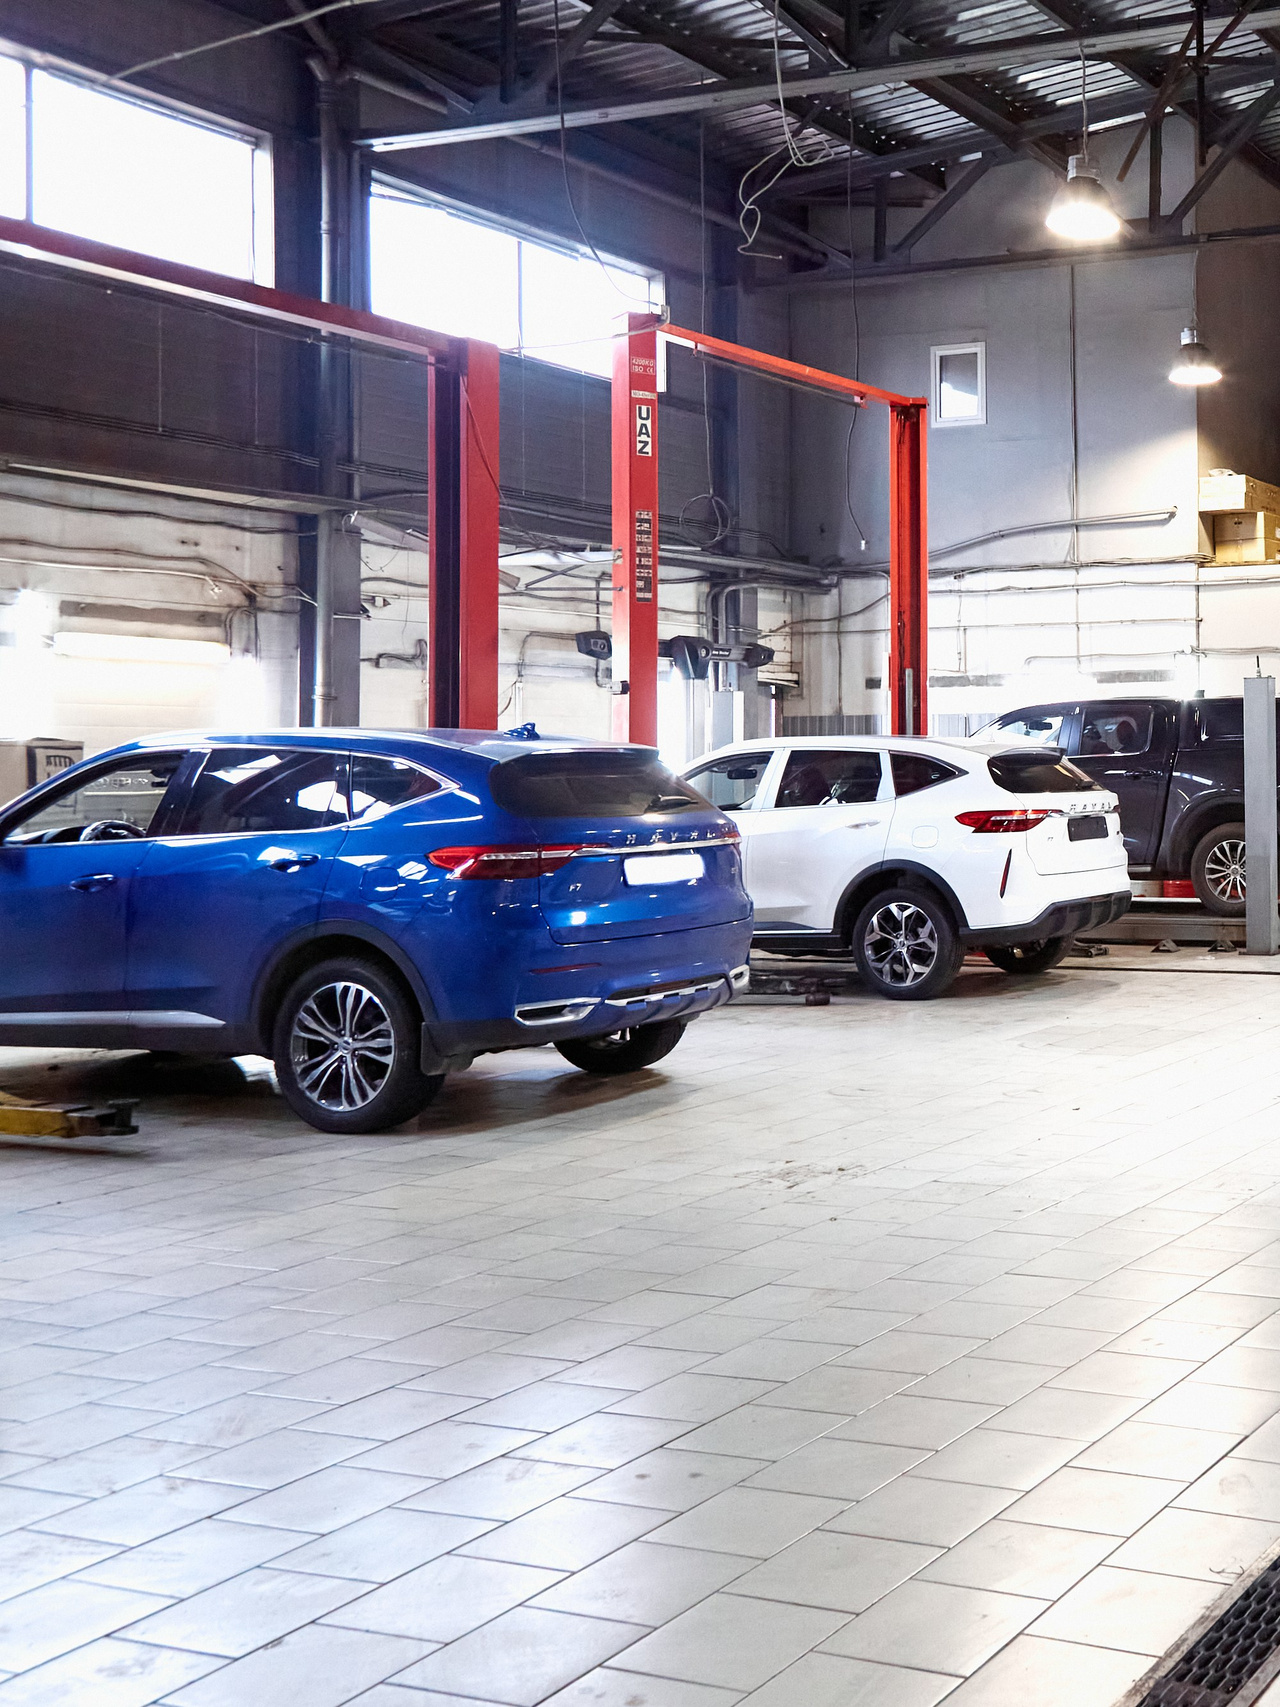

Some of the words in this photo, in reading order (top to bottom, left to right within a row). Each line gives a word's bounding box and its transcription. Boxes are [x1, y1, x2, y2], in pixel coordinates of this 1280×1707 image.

[637, 406, 651, 455] UAZ
[625, 831, 715, 845] HAVAL
[568, 883, 582, 892] F7
